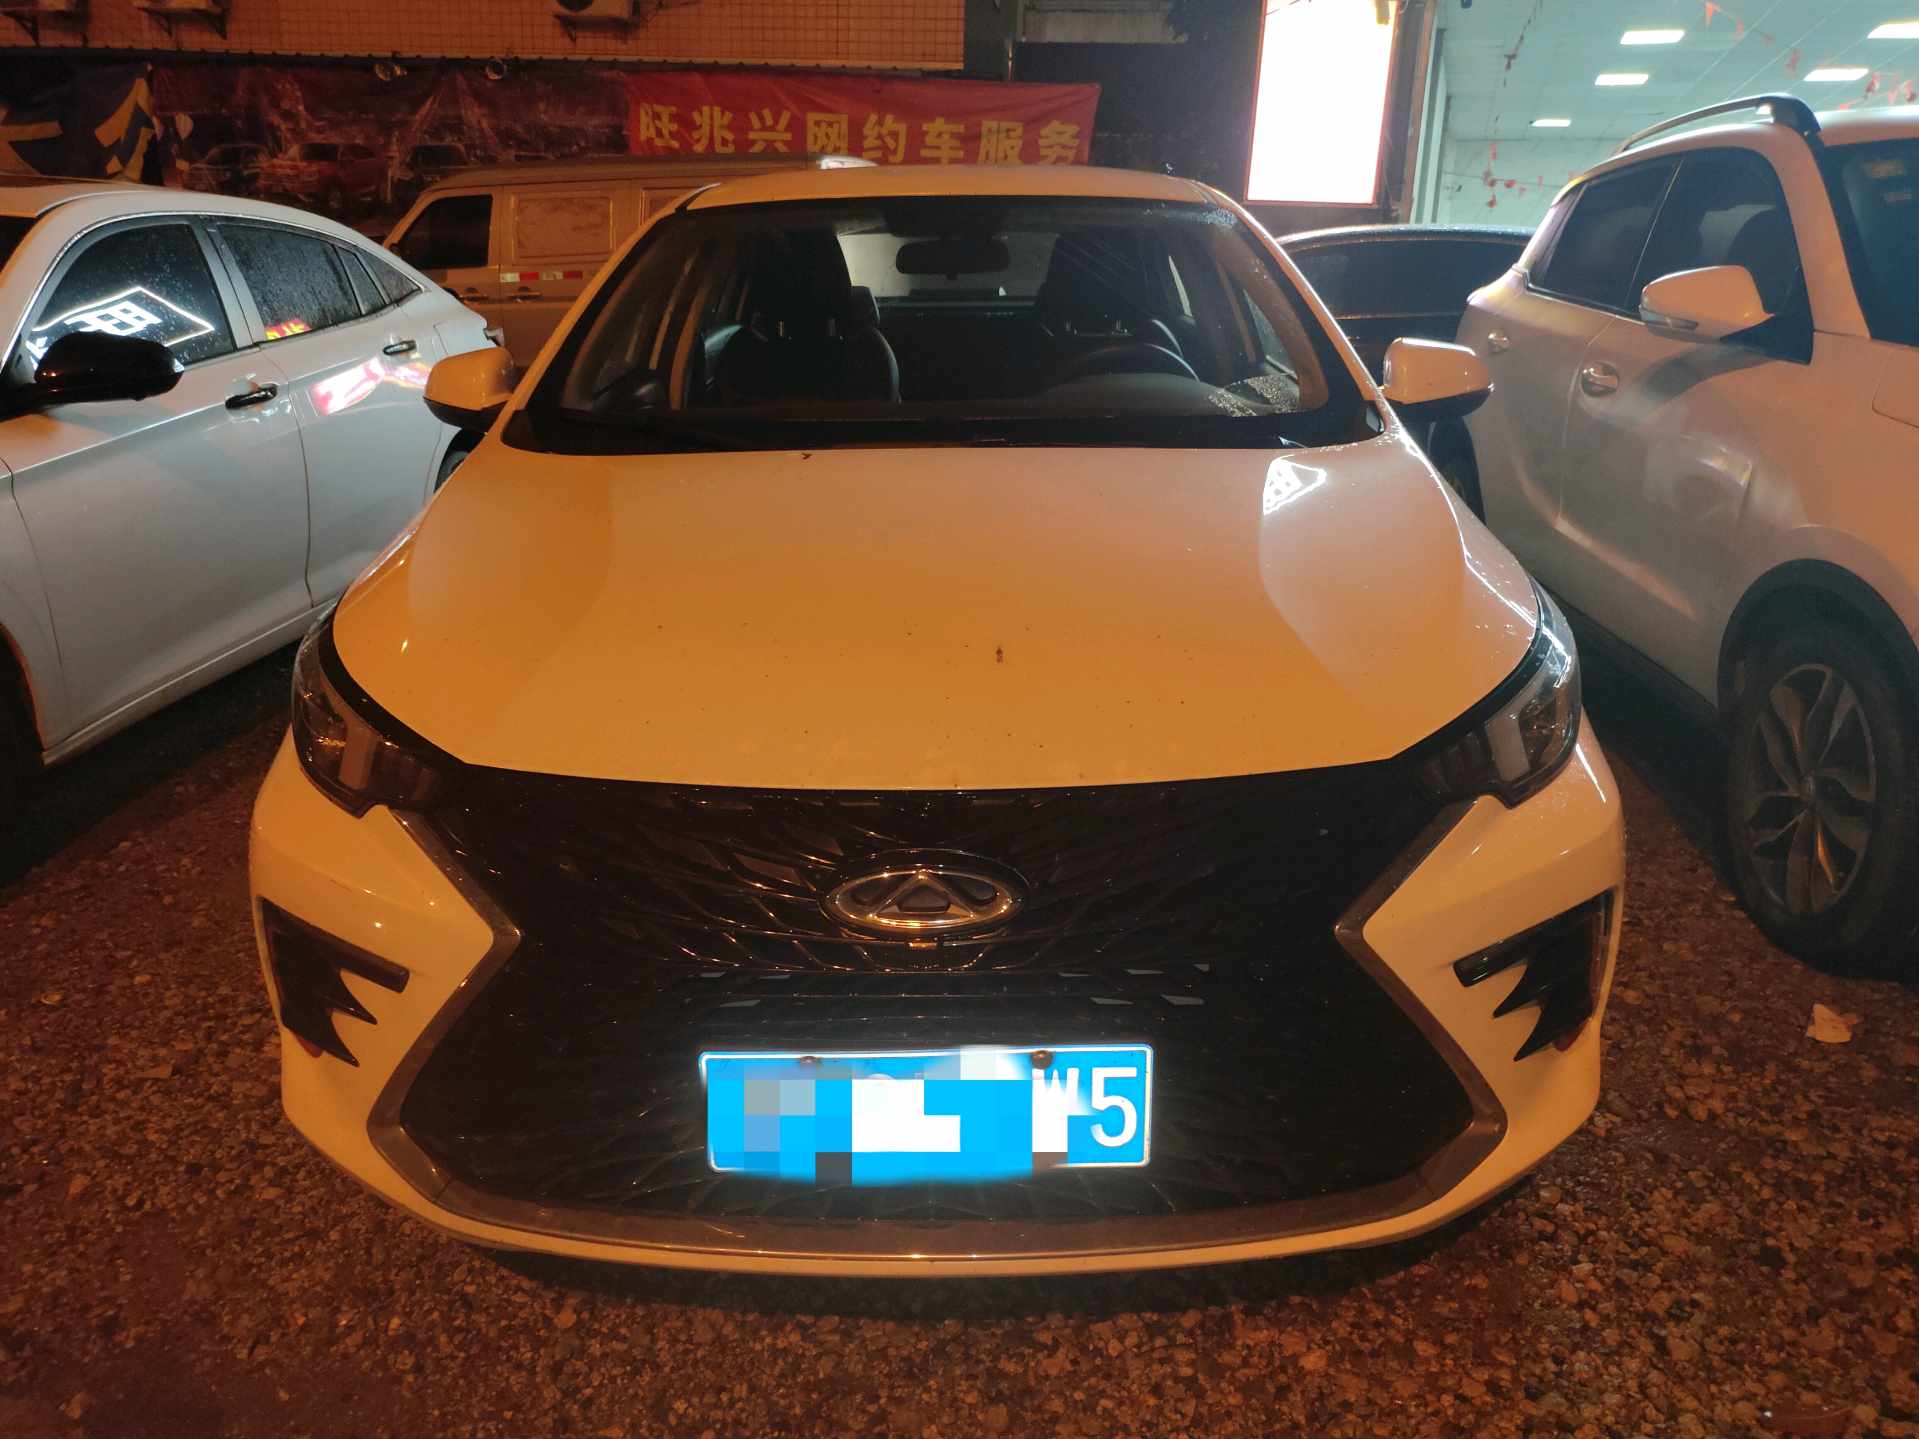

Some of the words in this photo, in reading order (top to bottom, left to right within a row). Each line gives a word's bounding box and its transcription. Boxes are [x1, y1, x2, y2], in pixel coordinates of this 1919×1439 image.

[639, 102, 1080, 165] 旺兆兴网约车服务
